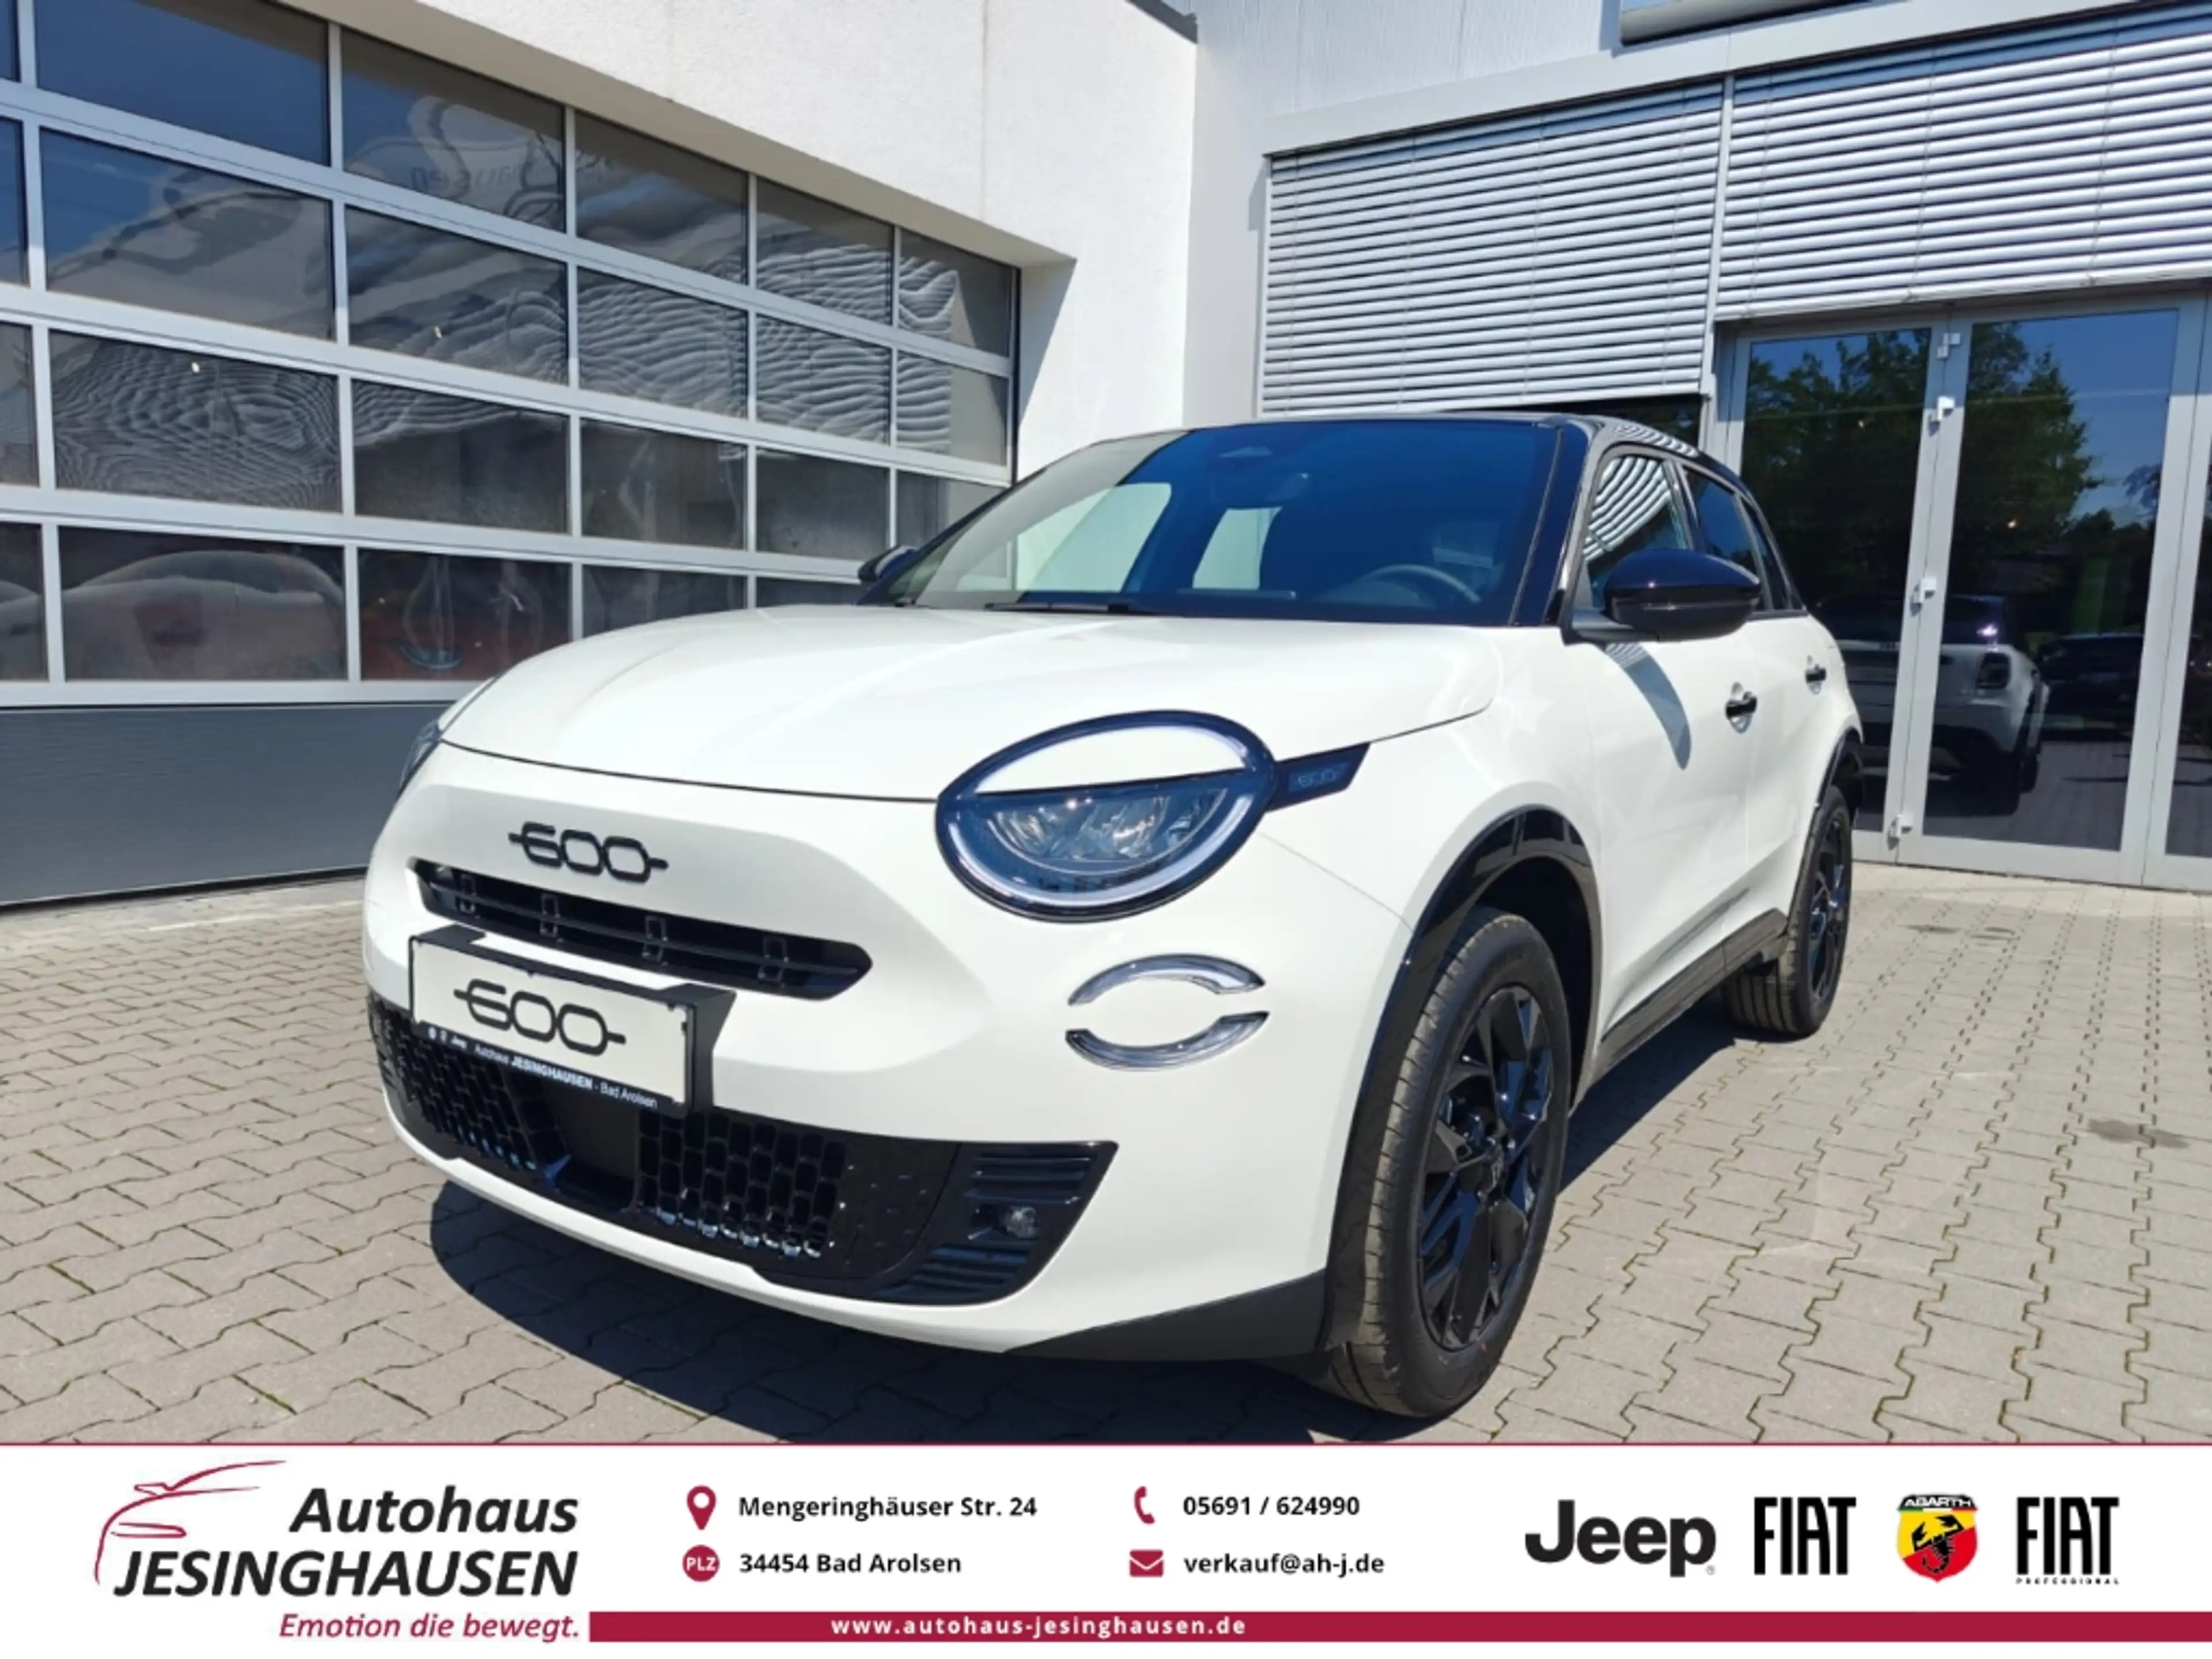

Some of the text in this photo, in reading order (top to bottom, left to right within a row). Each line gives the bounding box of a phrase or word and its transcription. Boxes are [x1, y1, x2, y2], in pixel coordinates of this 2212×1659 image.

[507, 820, 669, 883] 600
[453, 978, 627, 1056] 600
[474, 1043, 510, 1065] Autohaus
[512, 1055, 593, 1090] JESINGHAUSEN
[600, 1082, 620, 1099] Bad
[621, 1090, 658, 1109] Arolsen
